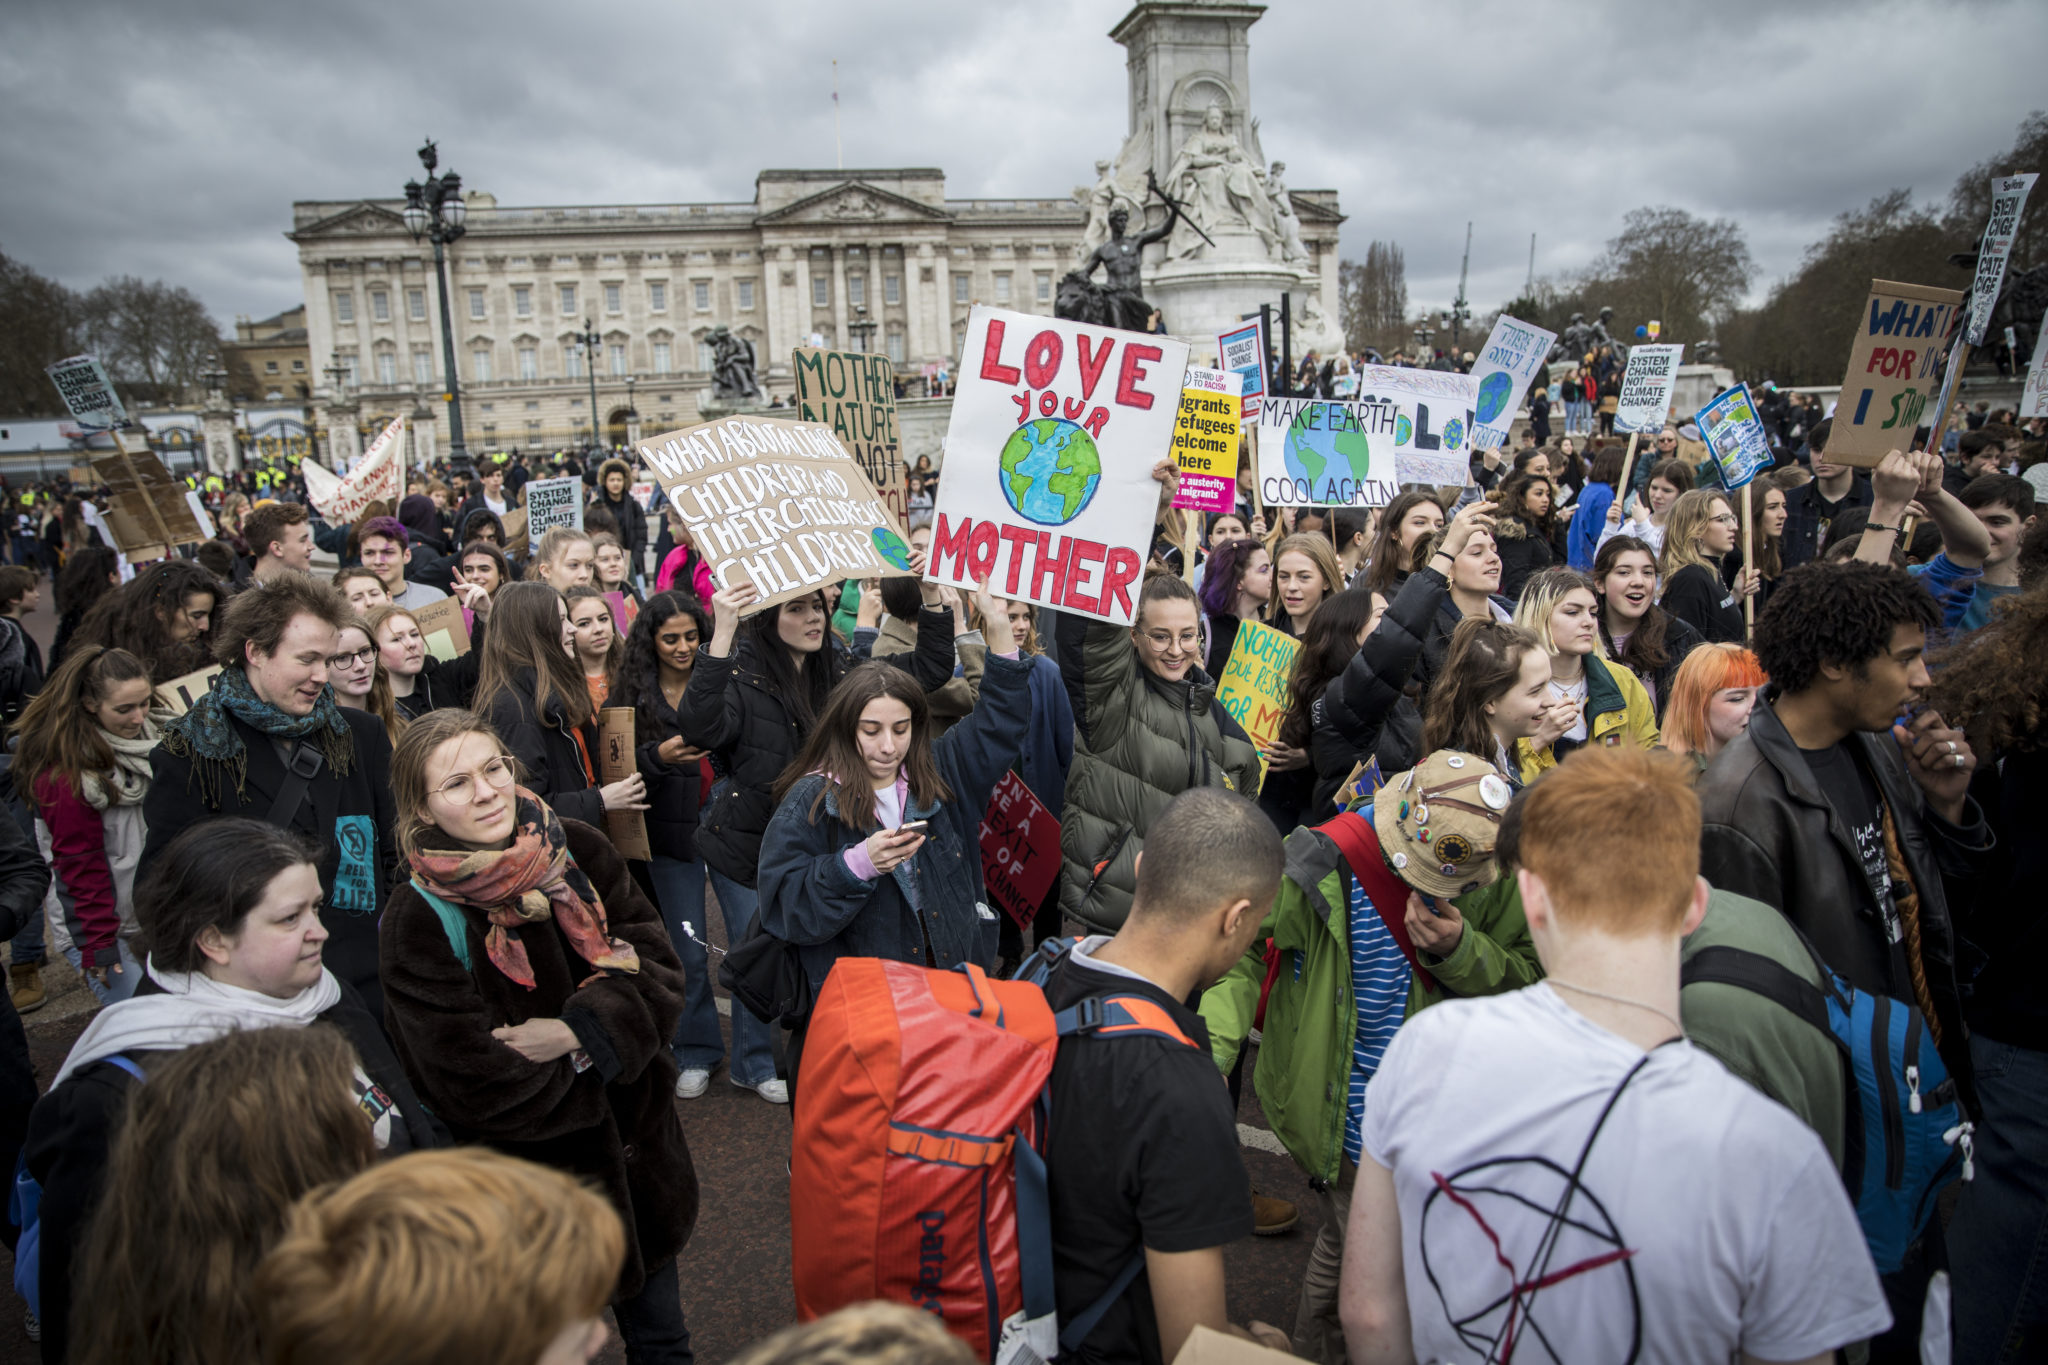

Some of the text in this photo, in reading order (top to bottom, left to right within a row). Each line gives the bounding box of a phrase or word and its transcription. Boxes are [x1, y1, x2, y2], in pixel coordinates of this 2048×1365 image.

[1869, 299, 1944, 338] WHAT
[1227, 340, 1253, 357] SOCIALIST
[1501, 322, 1550, 357] THERE IS
[979, 318, 1164, 411] LOVE
[1231, 352, 1252, 368] CHANGE
[1488, 346, 1524, 371] ONLY
[1630, 356, 1670, 367] SYSTEM
[1866, 347, 1917, 380] FOR
[53, 365, 94, 381] SYSTEM
[59, 373, 101, 390] CHANGE
[796, 350, 895, 405] MOTHER
[1194, 371, 1225, 383] STAND UP
[1243, 366, 1260, 380] MATE
[1628, 366, 1669, 377] CHANGE
[63, 386, 86, 398] NOT
[1193, 379, 1226, 392] TO RACISM
[1623, 387, 1666, 397] CLIMATE
[1625, 377, 1645, 387] NOT
[69, 390, 112, 407] CLIMATE
[73, 400, 113, 415] CHANGE
[1181, 393, 1231, 415] igrants
[1621, 397, 1662, 407] CHANGE
[1853, 387, 1927, 430] I STAND
[802, 402, 898, 444] NATURE
[1011, 389, 1111, 440] YOUR
[1261, 400, 1398, 435] MAKE EARTH
[641, 427, 725, 479] WHAT
[717, 420, 779, 462] ABOUT
[794, 426, 851, 459] THESE
[855, 443, 898, 487] NOT
[1178, 451, 1212, 470] here
[529, 487, 572, 500] SYSTEM
[669, 462, 849, 524] CHILDREN? AND
[1181, 487, 1219, 499] migrants
[1187, 478, 1226, 490] austerity,
[1264, 477, 1322, 505] COOL
[530, 495, 574, 509] CHANGE
[530, 507, 552, 518] NOT
[531, 512, 576, 527] CLIMATE
[531, 521, 576, 536] CHGE
[689, 506, 792, 561] THEIR
[716, 529, 885, 604] CHILDREN?
[928, 512, 1141, 621] MOTHER
[1226, 652, 1253, 683] but
[1000, 771, 1042, 819] ON'T
[1017, 817, 1031, 837] A
[996, 847, 1024, 876] OF
[351, 878, 367, 889] FOR
[338, 888, 375, 909] LIFE
[986, 863, 1035, 925] CHANGE
[910, 1209, 948, 1324] patago
